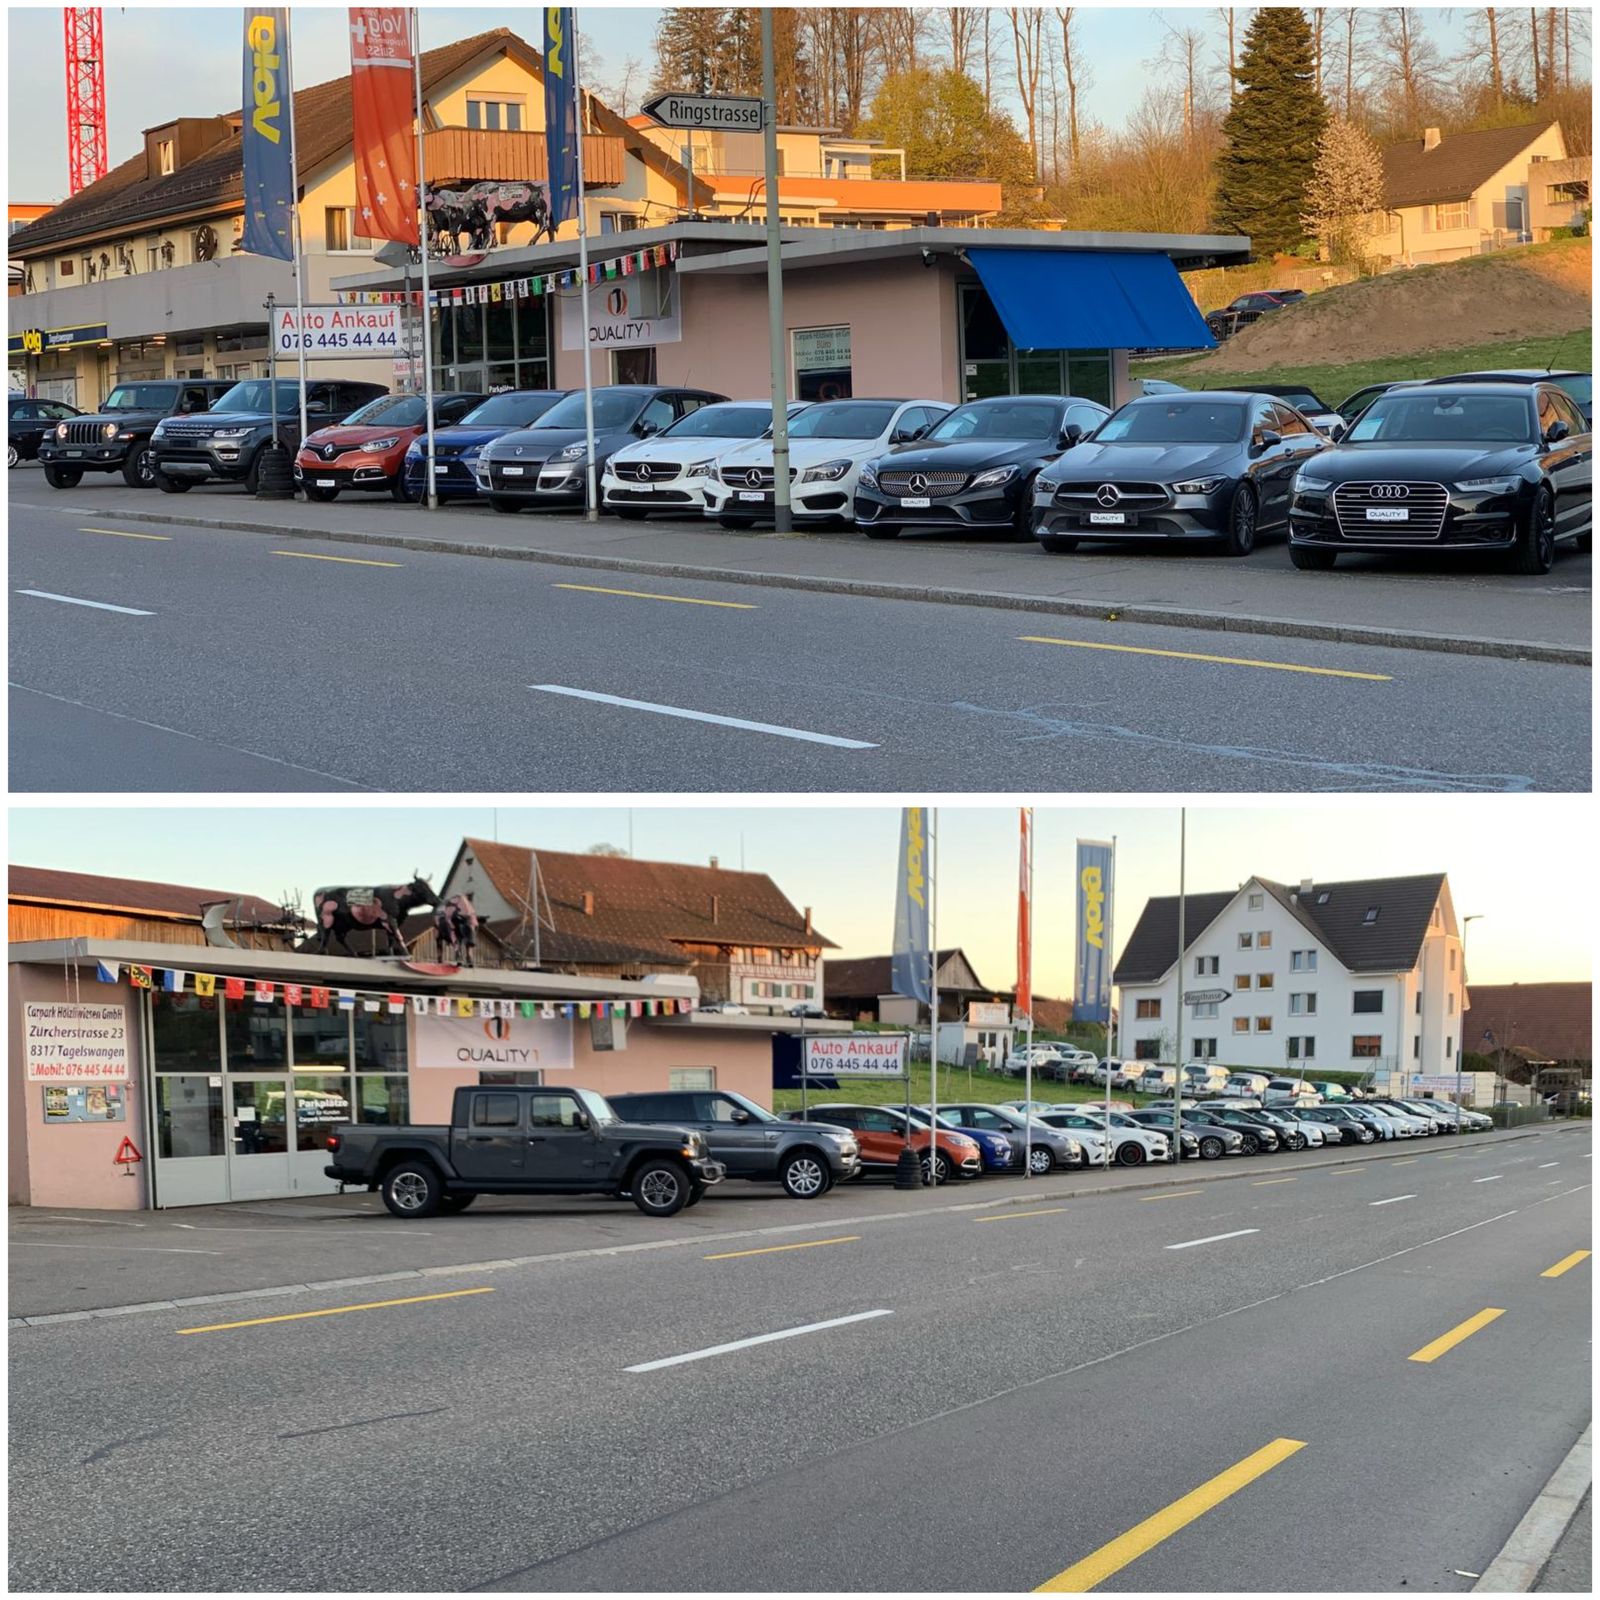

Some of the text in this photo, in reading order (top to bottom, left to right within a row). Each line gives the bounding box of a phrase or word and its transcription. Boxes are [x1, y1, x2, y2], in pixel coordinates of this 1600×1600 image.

[669, 100, 758, 125] Ringstrasse
[331, 310, 395, 328] Ankauf
[22, 328, 42, 352] Volg
[281, 333, 313, 348] 076
[317, 333, 348, 347] 445
[352, 332, 373, 346] 44
[377, 331, 397, 346] 44
[27, 1005, 56, 1020] Carpark
[102, 1008, 123, 1020] GmbH
[29, 1025, 124, 1039] Zürcherstrasse 23
[30, 1045, 125, 1060] 8317 Tagelswangen
[811, 1040, 898, 1055] Auto Ankauf
[35, 1062, 125, 1076] Mobil: 076 445 44 44
[811, 1057, 898, 1070] 076 445 44 44
[298, 1099, 348, 1109] Parkplätze
